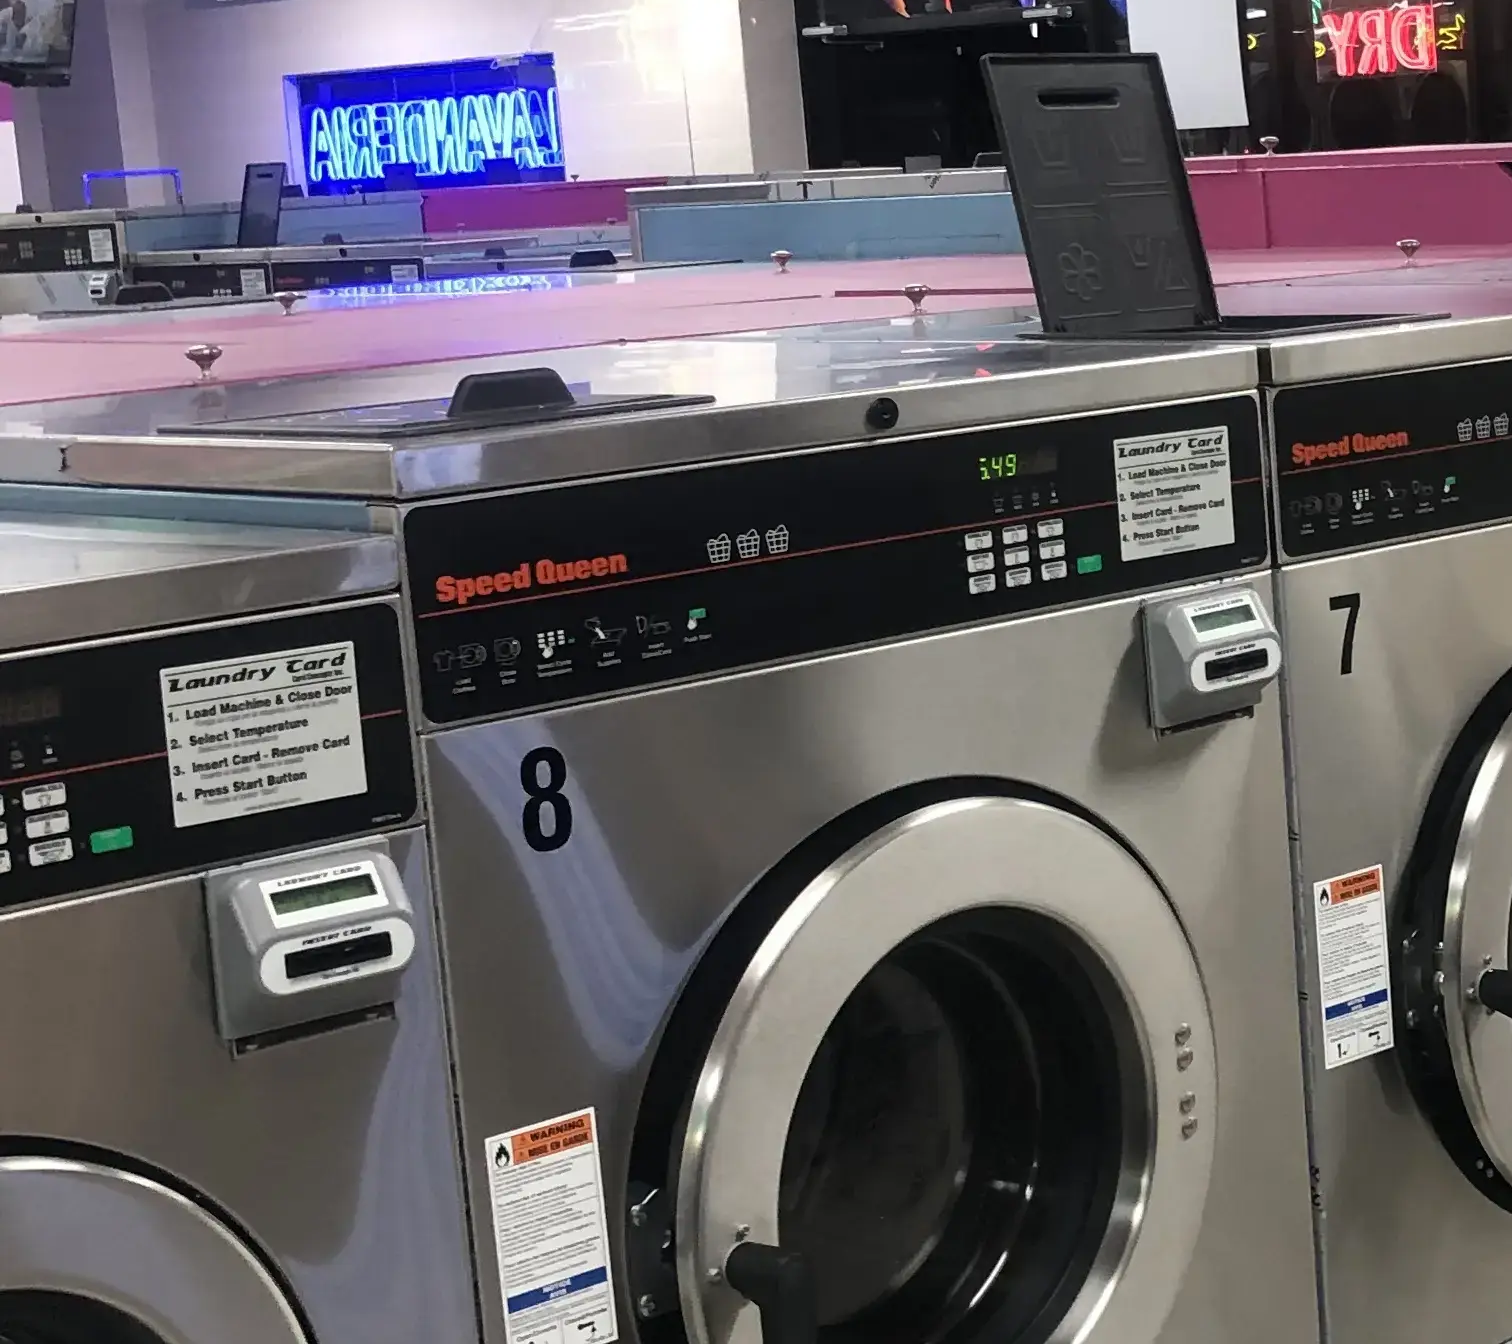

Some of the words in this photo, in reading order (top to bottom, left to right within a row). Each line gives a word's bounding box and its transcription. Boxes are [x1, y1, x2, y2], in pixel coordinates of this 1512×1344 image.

[1118, 442, 1181, 458] Laundry
[1188, 435, 1223, 448] Card
[1292, 436, 1349, 465] Speed
[1353, 431, 1409, 453] Queen
[436, 563, 530, 604] Speed
[536, 553, 628, 585] Queen
[1330, 594, 1360, 675] 7
[168, 666, 276, 693] Laundry
[286, 653, 346, 673] Card
[168, 713, 179, 722] 1.
[186, 706, 216, 720] Load
[220, 697, 271, 713] Machine
[275, 694, 284, 705] &
[288, 688, 321, 703] Close
[325, 685, 352, 696] Door
[170, 739, 182, 750] 2.
[190, 731, 229, 746] Select
[232, 718, 308, 738] Temperature
[173, 766, 185, 776] 3.
[192, 757, 228, 773] Insert
[232, 752, 261, 766] Card
[271, 743, 319, 758] Remove
[323, 735, 350, 749] Card
[176, 792, 187, 802] 4.
[195, 785, 229, 799] Press
[233, 778, 263, 792] Start
[268, 771, 307, 786] Button
[520, 747, 572, 852] 8
[530, 1119, 584, 1142] WARNING
